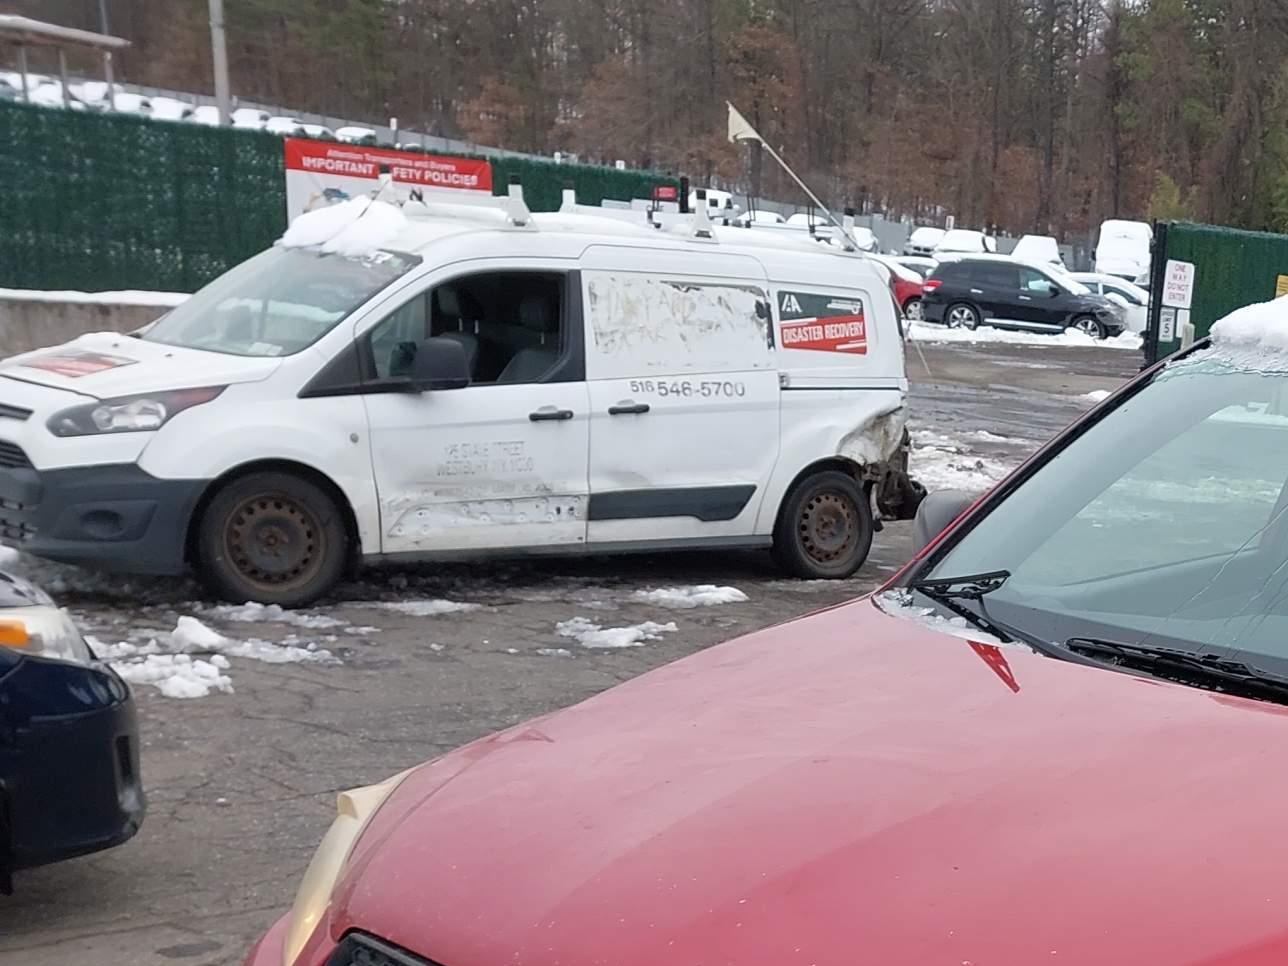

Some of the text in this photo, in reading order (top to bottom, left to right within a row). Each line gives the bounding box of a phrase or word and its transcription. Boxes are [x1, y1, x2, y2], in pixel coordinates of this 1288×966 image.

[415, 159, 428, 167] and
[302, 156, 478, 186] IMPORTANT FETY POLICIES
[1175, 263, 1186, 272] ONE
[783, 321, 864, 344] DISASTER RECOVERY
[1163, 323, 1170, 334] 5
[629, 380, 746, 397] 516 546-5700
